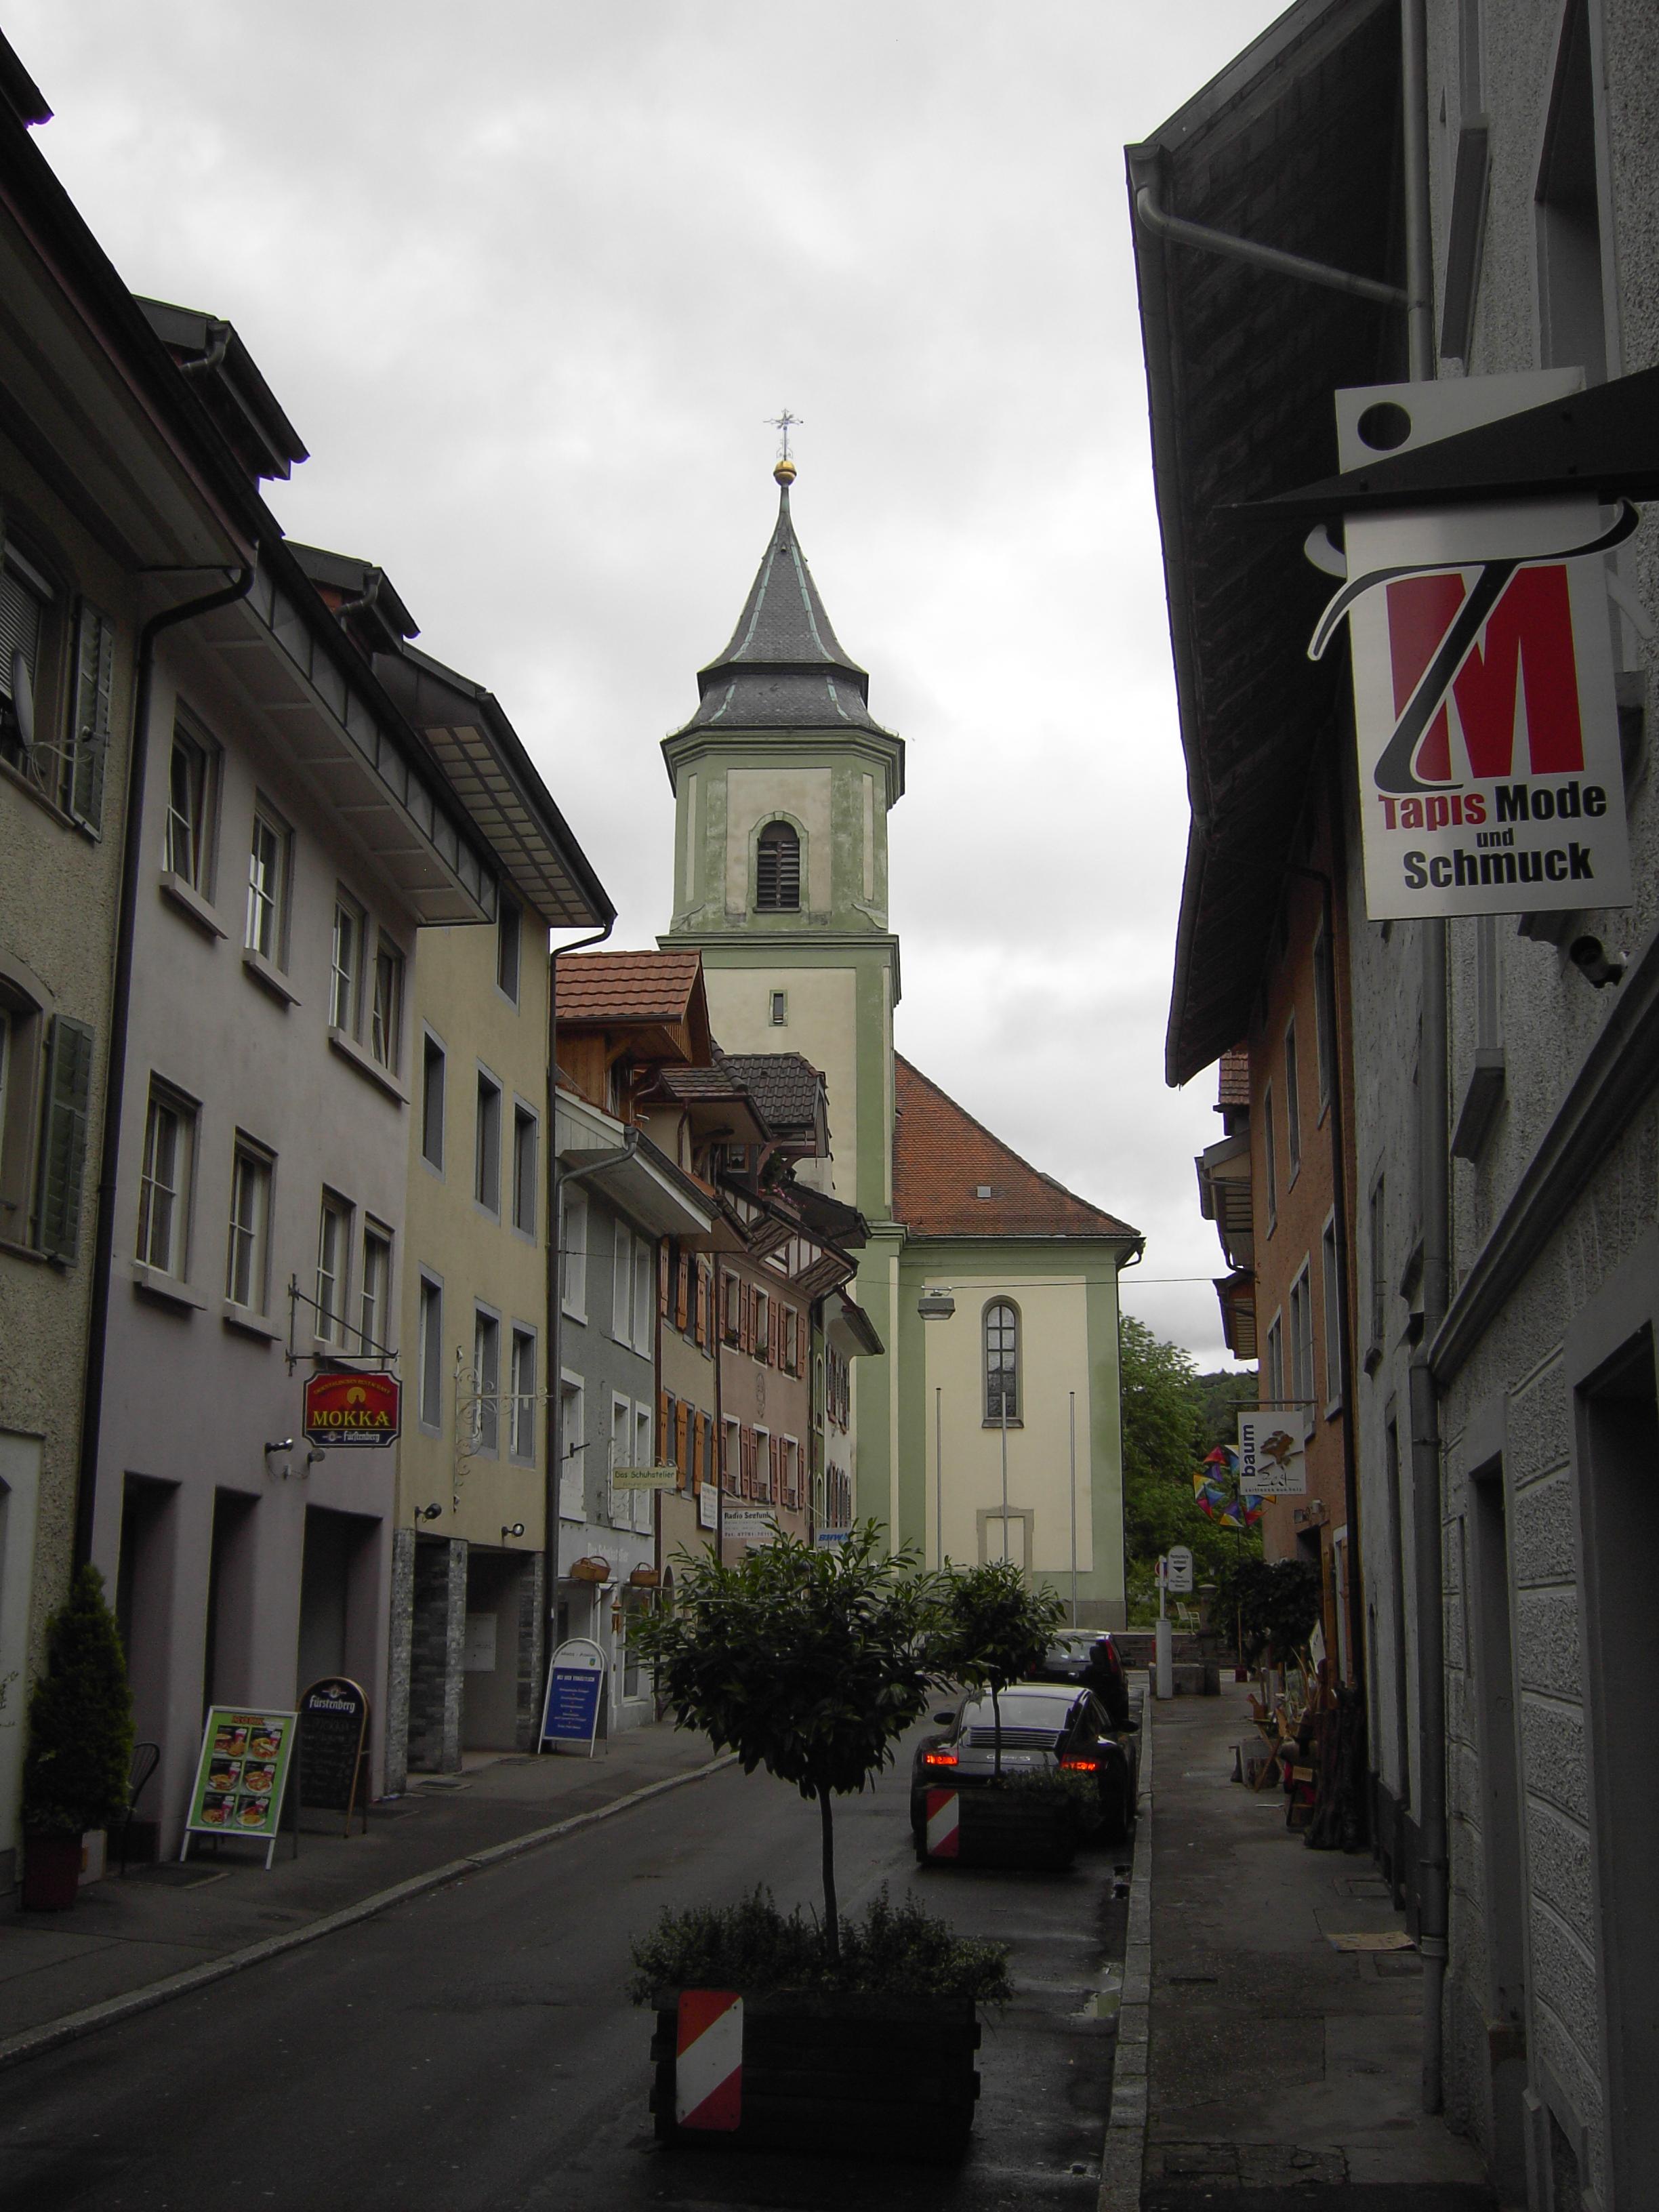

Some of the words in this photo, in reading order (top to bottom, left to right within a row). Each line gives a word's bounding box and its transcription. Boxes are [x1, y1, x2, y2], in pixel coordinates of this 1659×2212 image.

[1378, 793, 1488, 831] Tapis
[1495, 781, 1608, 823] Mode
[1476, 827, 1515, 848] und
[1404, 842, 1595, 889] Schmuck
[312, 1410, 391, 1427] MOKKA
[1242, 1425, 1256, 1477] baum
[631, 1470, 674, 1479] Schuhatelier
